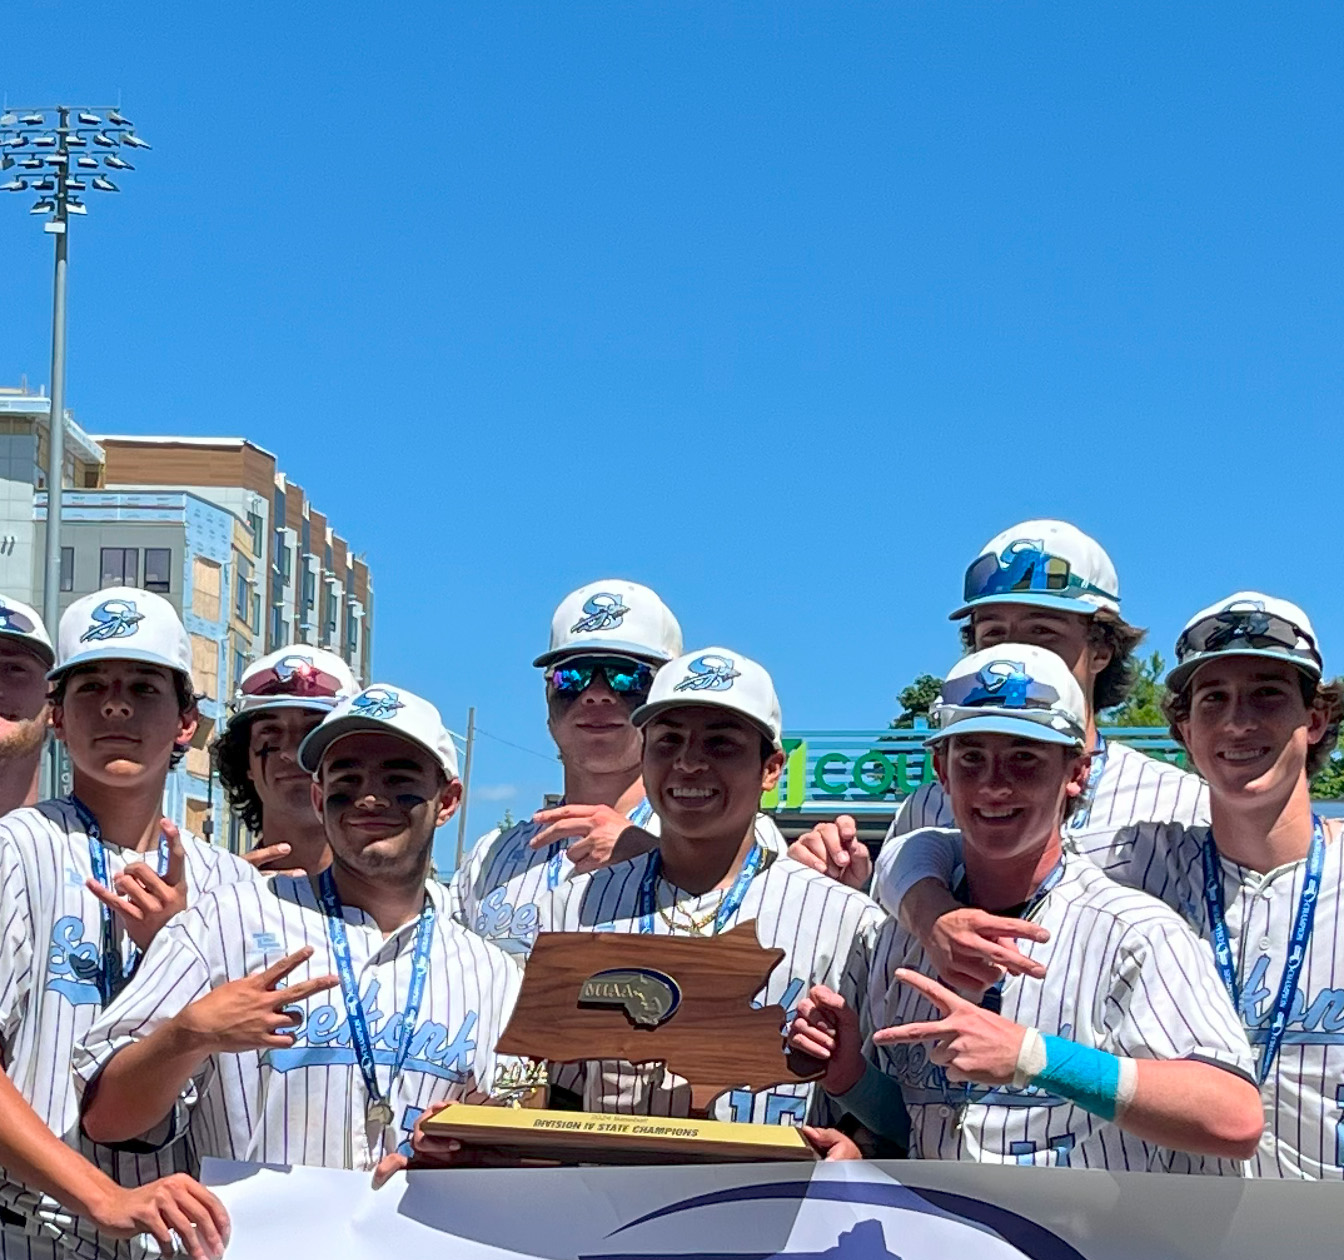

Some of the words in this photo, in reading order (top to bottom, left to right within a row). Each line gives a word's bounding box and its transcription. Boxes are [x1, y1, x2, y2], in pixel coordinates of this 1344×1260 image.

[533, 1118, 582, 1130] DIVISION
[584, 1121, 595, 1131] IV
[597, 1123, 630, 1133] STATE
[632, 1124, 699, 1137] CHAMPIONS
